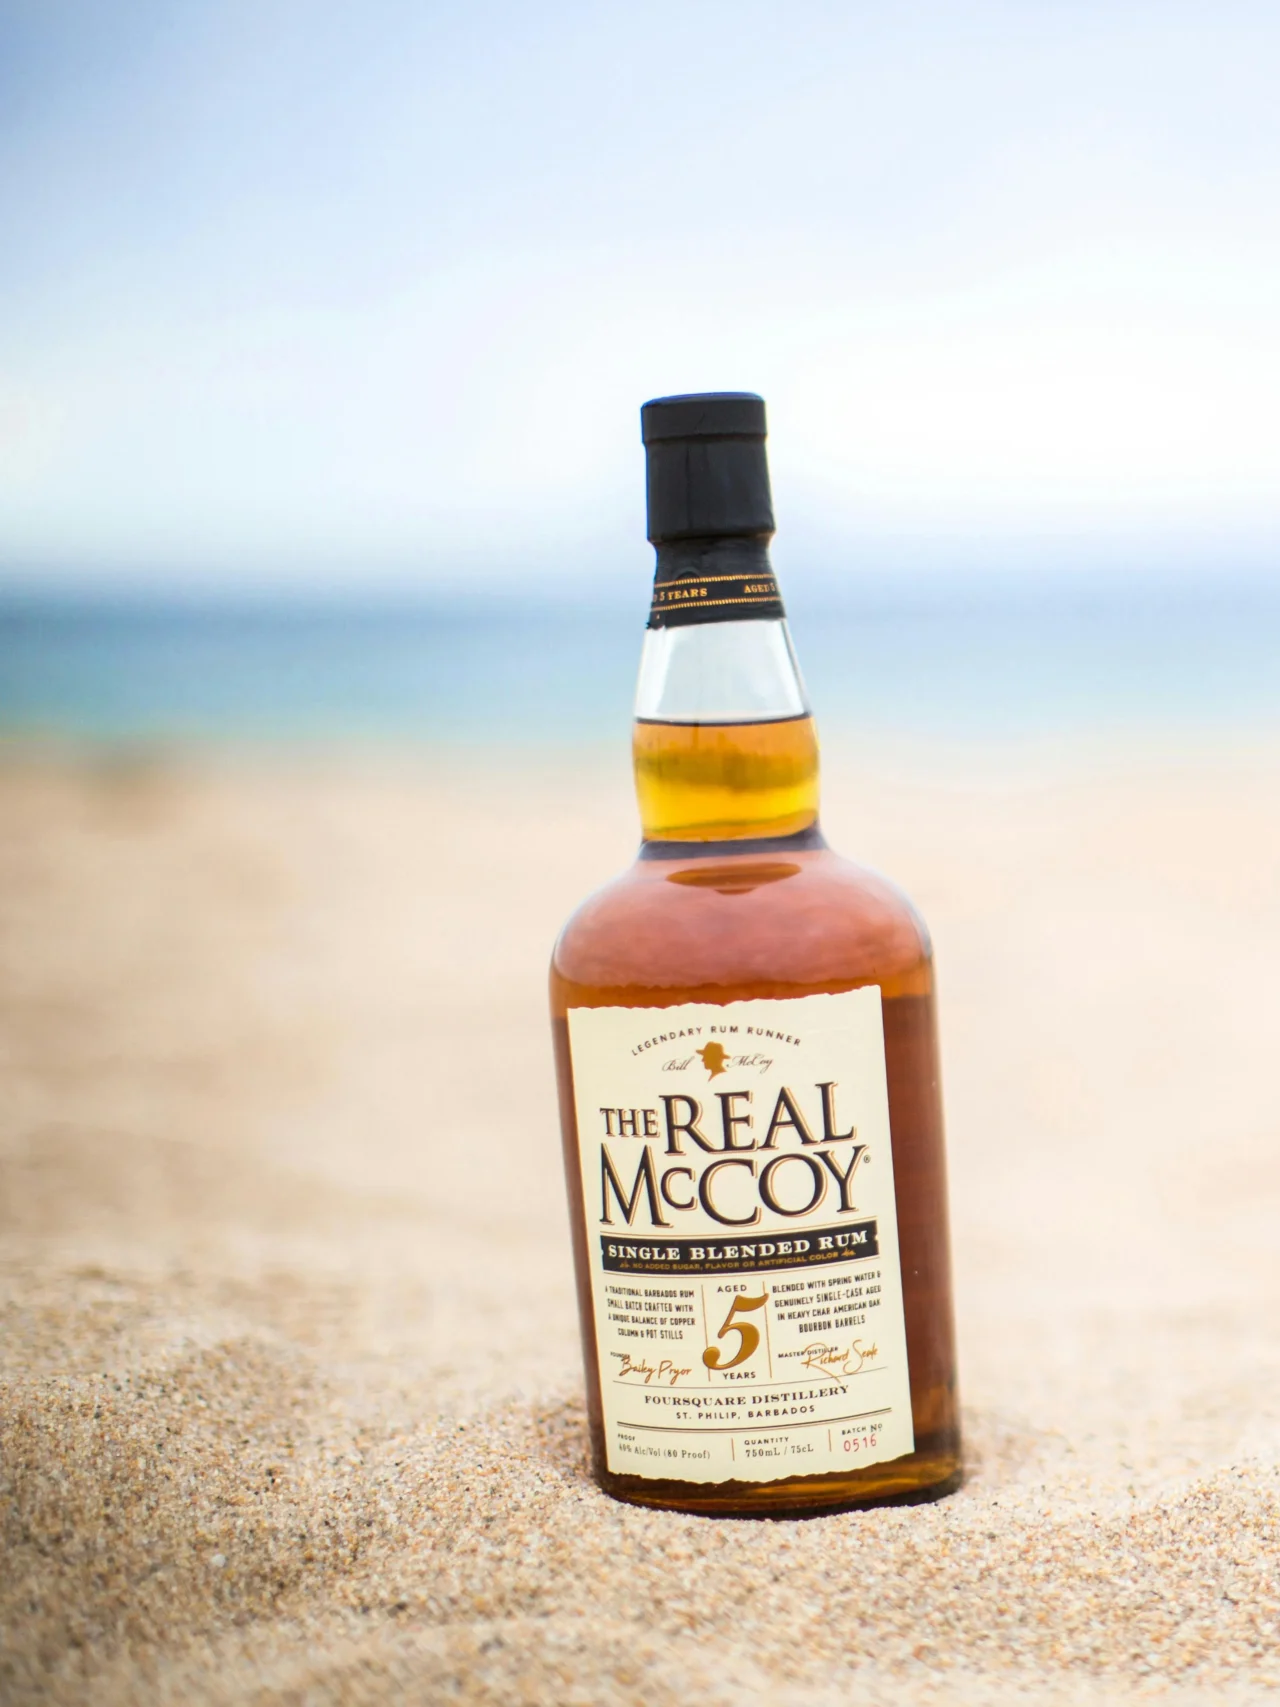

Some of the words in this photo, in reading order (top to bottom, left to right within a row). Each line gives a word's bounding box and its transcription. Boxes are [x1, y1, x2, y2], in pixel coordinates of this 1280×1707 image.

[668, 588, 708, 600] YEARS
[744, 584, 769, 594] AGED
[632, 1026, 702, 1056] LEGENDARY
[710, 1025, 739, 1034] RUM
[747, 1026, 801, 1046] RUNNER
[662, 1055, 696, 1072] Bill
[726, 1053, 774, 1074] McCoy
[600, 1107, 660, 1138] THE
[659, 1081, 857, 1156] REAL
[608, 1244, 681, 1261] SINGLE
[689, 1239, 811, 1261] BLENDED
[818, 1230, 868, 1250] RUM
[645, 1262, 671, 1270] ADDED
[705, 1262, 740, 1270] FLAVOR
[742, 1260, 756, 1268] OR
[758, 1256, 808, 1267] ARTIFICIAL
[809, 1251, 839, 1261] COLOR
[717, 1284, 747, 1293] AGED
[772, 1282, 805, 1294] BLENDED
[807, 1279, 826, 1289] WITH
[827, 1275, 852, 1287] SPRING
[854, 1271, 876, 1282] WATER
[609, 1285, 643, 1297] TRADITIONAL
[644, 1288, 678, 1298] BARBADOS
[679, 1289, 695, 1298] RUM
[774, 1296, 814, 1308] GENUINELY
[816, 1287, 863, 1303] SINGLE-CASK
[866, 1284, 882, 1295] AGED
[606, 1298, 624, 1310] SMALL
[624, 1300, 643, 1311] BATCH
[644, 1302, 673, 1313] CRAFTED
[674, 1304, 694, 1313] WITH
[777, 1312, 786, 1321] IN
[787, 1309, 811, 1320] HEAVY
[812, 1307, 831, 1317] CHAR
[833, 1301, 868, 1315] AMERICAN
[868, 1298, 881, 1308] OAK
[612, 1313, 631, 1324] UNIQUE
[631, 1315, 658, 1326] BALANCE
[659, 1317, 668, 1326] OF
[669, 1317, 696, 1326] COPPER
[798, 1319, 832, 1334] BOURBON
[835, 1314, 866, 1329] BARRELS
[617, 1327, 639, 1338] COLUMN
[646, 1329, 658, 1339] POT
[659, 1330, 684, 1340] STILLS
[702, 1292, 770, 1371] 5
[778, 1350, 805, 1359] MASTER
[658, 1359, 692, 1385] Pryor
[723, 1371, 756, 1380] YEARS
[644, 1395, 747, 1408] FOURSQUARE
[752, 1384, 849, 1405] DISTILLERY
[676, 1411, 692, 1420] ST.
[697, 1411, 741, 1421] PHILIP,
[748, 1405, 815, 1418] BARBADOS
[617, 1433, 636, 1442] PROOF
[841, 1426, 867, 1436] BATCH
[744, 1436, 789, 1446] QUANTITY
[843, 1433, 877, 1452] 0516
[634, 1445, 661, 1457] Alc/Vol
[663, 1449, 678, 1459] (80
[681, 1449, 711, 1460] Proof)
[745, 1448, 780, 1458] 750mL
[790, 1444, 814, 1454] 75cL
